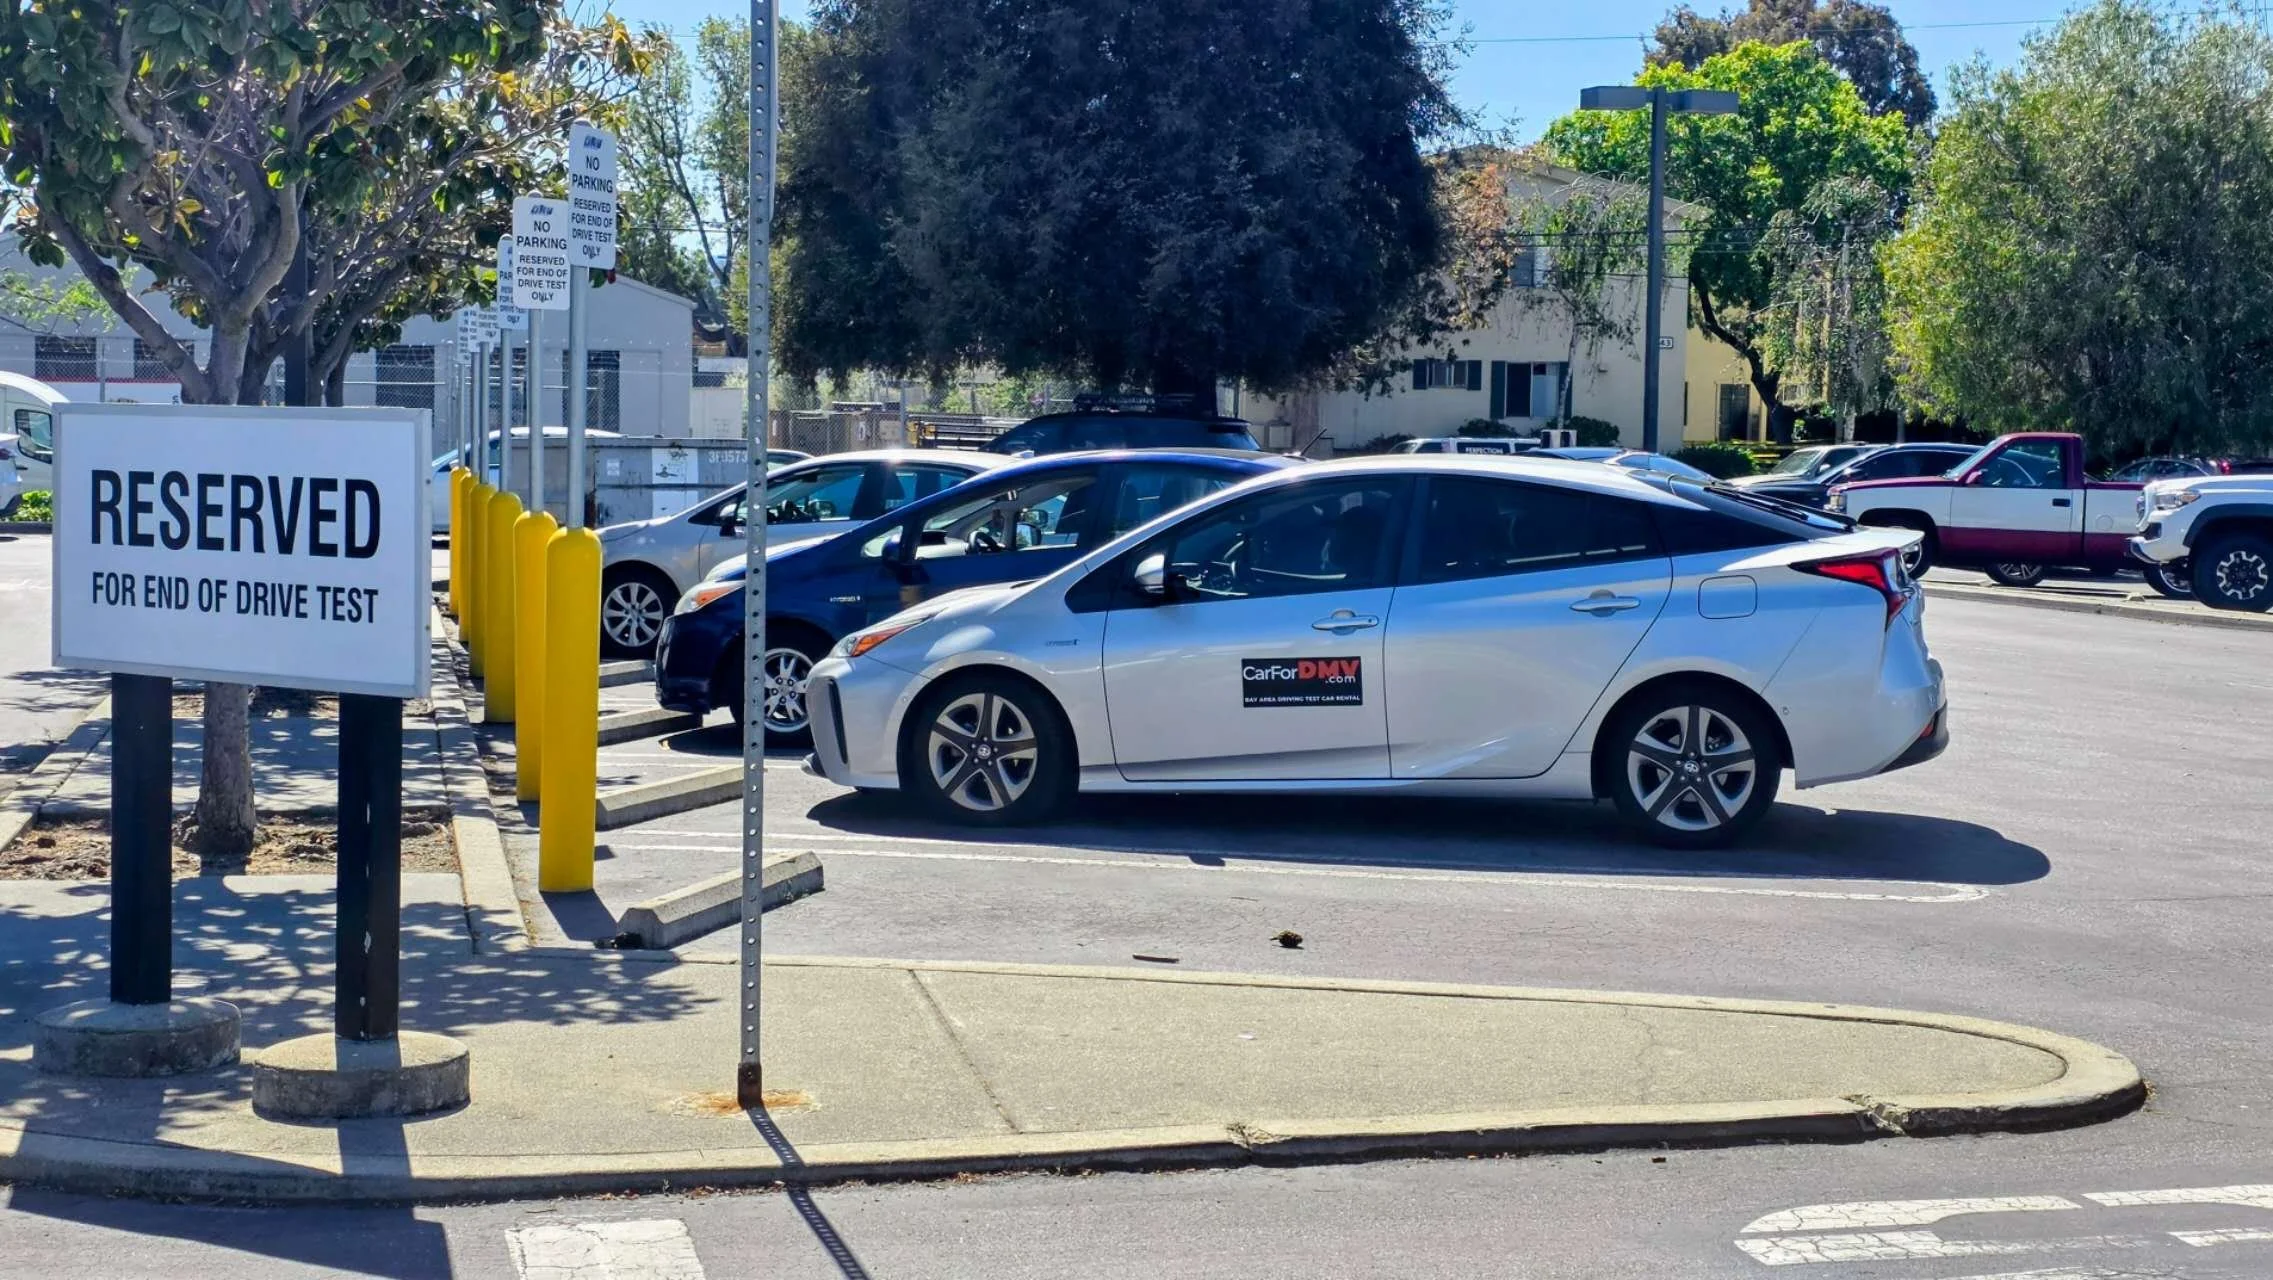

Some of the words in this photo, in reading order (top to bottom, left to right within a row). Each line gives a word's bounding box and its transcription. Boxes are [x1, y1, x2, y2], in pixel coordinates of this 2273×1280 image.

[586, 155, 600, 171] NO
[572, 173, 613, 193] PARKING
[574, 197, 611, 213] RESERVED
[533, 220, 551, 232] NO
[571, 212, 586, 224] FOR
[587, 215, 602, 227] END
[603, 217, 613, 228] OF
[516, 235, 567, 250] PARKING
[572, 228, 593, 240] DRIVE
[594, 230, 612, 243] TEST
[582, 244, 600, 257] ONLY
[519, 254, 565, 266] RESERVED
[516, 266, 534, 276] FOR
[536, 267, 554, 277] END
[556, 269, 568, 278] OF
[518, 278, 543, 289] DRIVE
[545, 279, 567, 290] TEST
[531, 291, 553, 302] ONLY
[91, 469, 380, 559] RESERVED
[92, 572, 136, 607] FOR
[144, 575, 189, 610] END
[198, 578, 227, 613] OF
[236, 581, 307, 619] DRIVE
[316, 586, 379, 624] TEST
